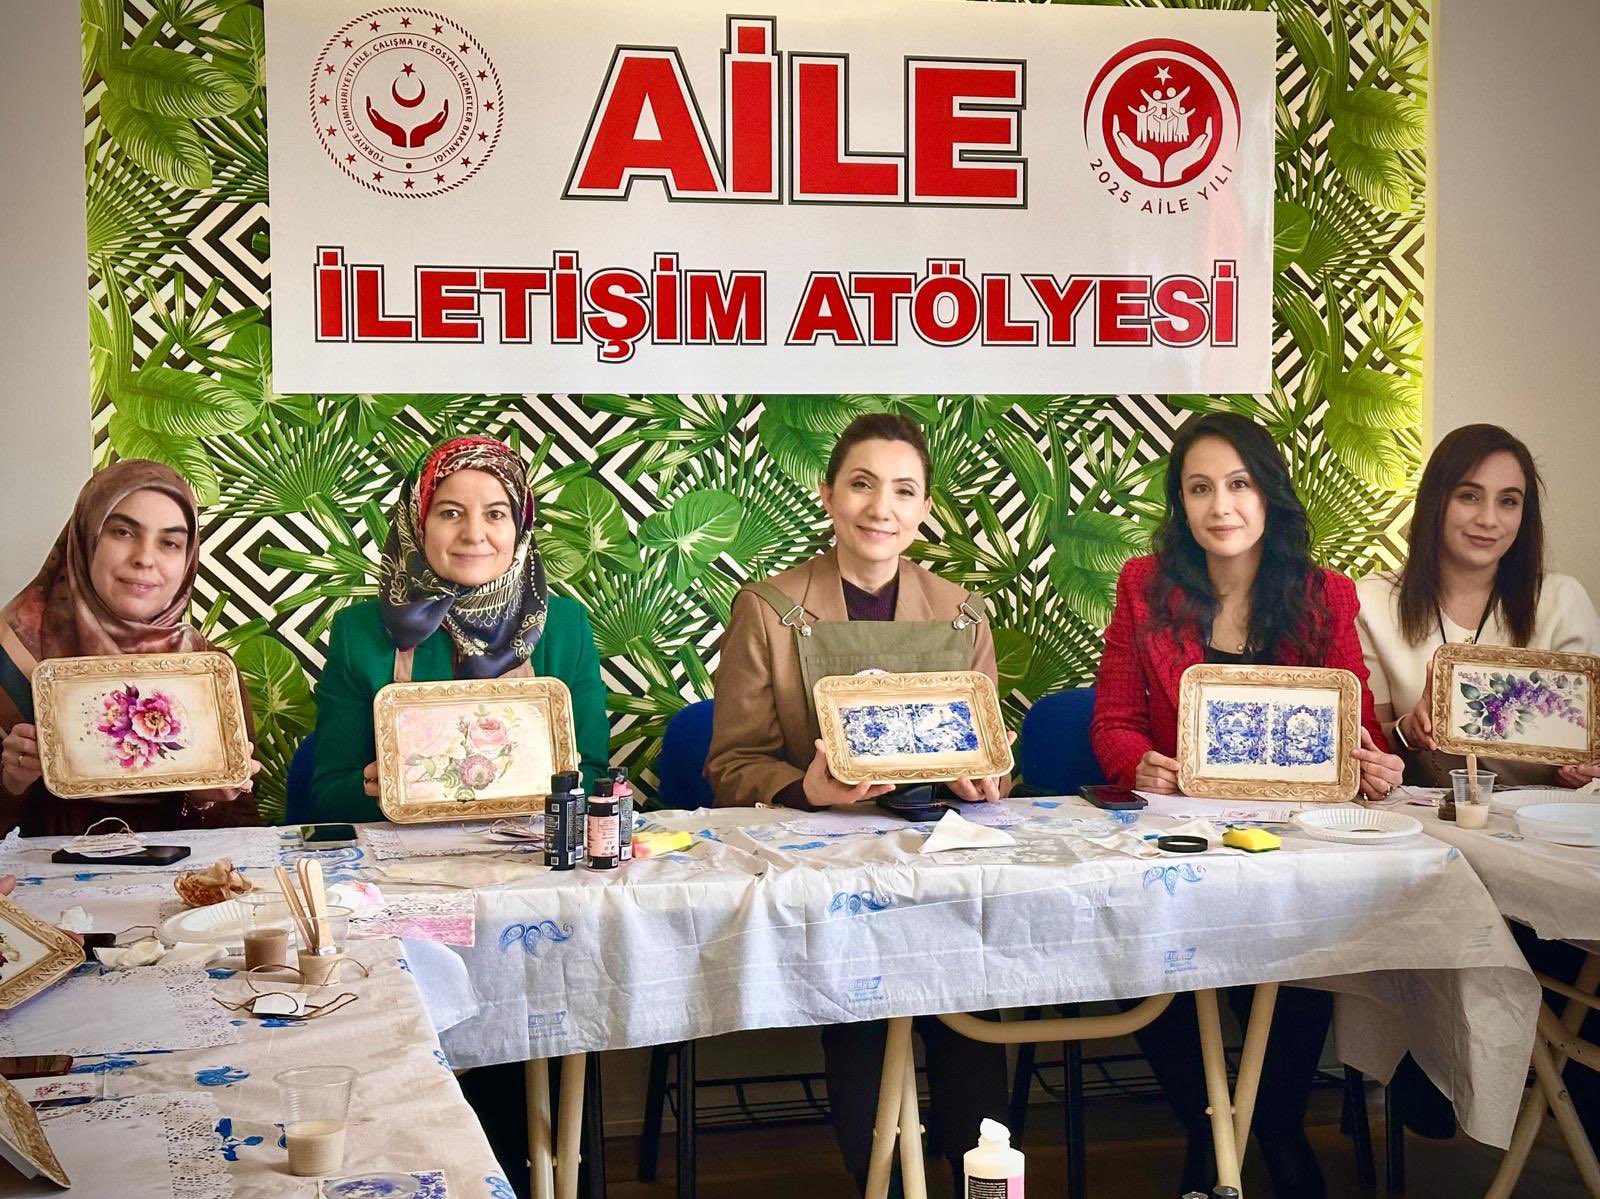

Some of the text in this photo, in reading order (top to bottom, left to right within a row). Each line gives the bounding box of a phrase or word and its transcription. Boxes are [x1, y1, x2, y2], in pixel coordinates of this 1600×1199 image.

[340, 38, 473, 163] TÜRKİYE CUMHURİYETİ AİLE, ÇALIŞMA VE SOSYAL HİZMETLER BAKANLIĞI
[560, 14, 1028, 209] AİLE
[1089, 158, 1233, 215] 2025 AİLE YILI
[313, 245, 1239, 363] İLETİŞİM ATÖLYESİ
